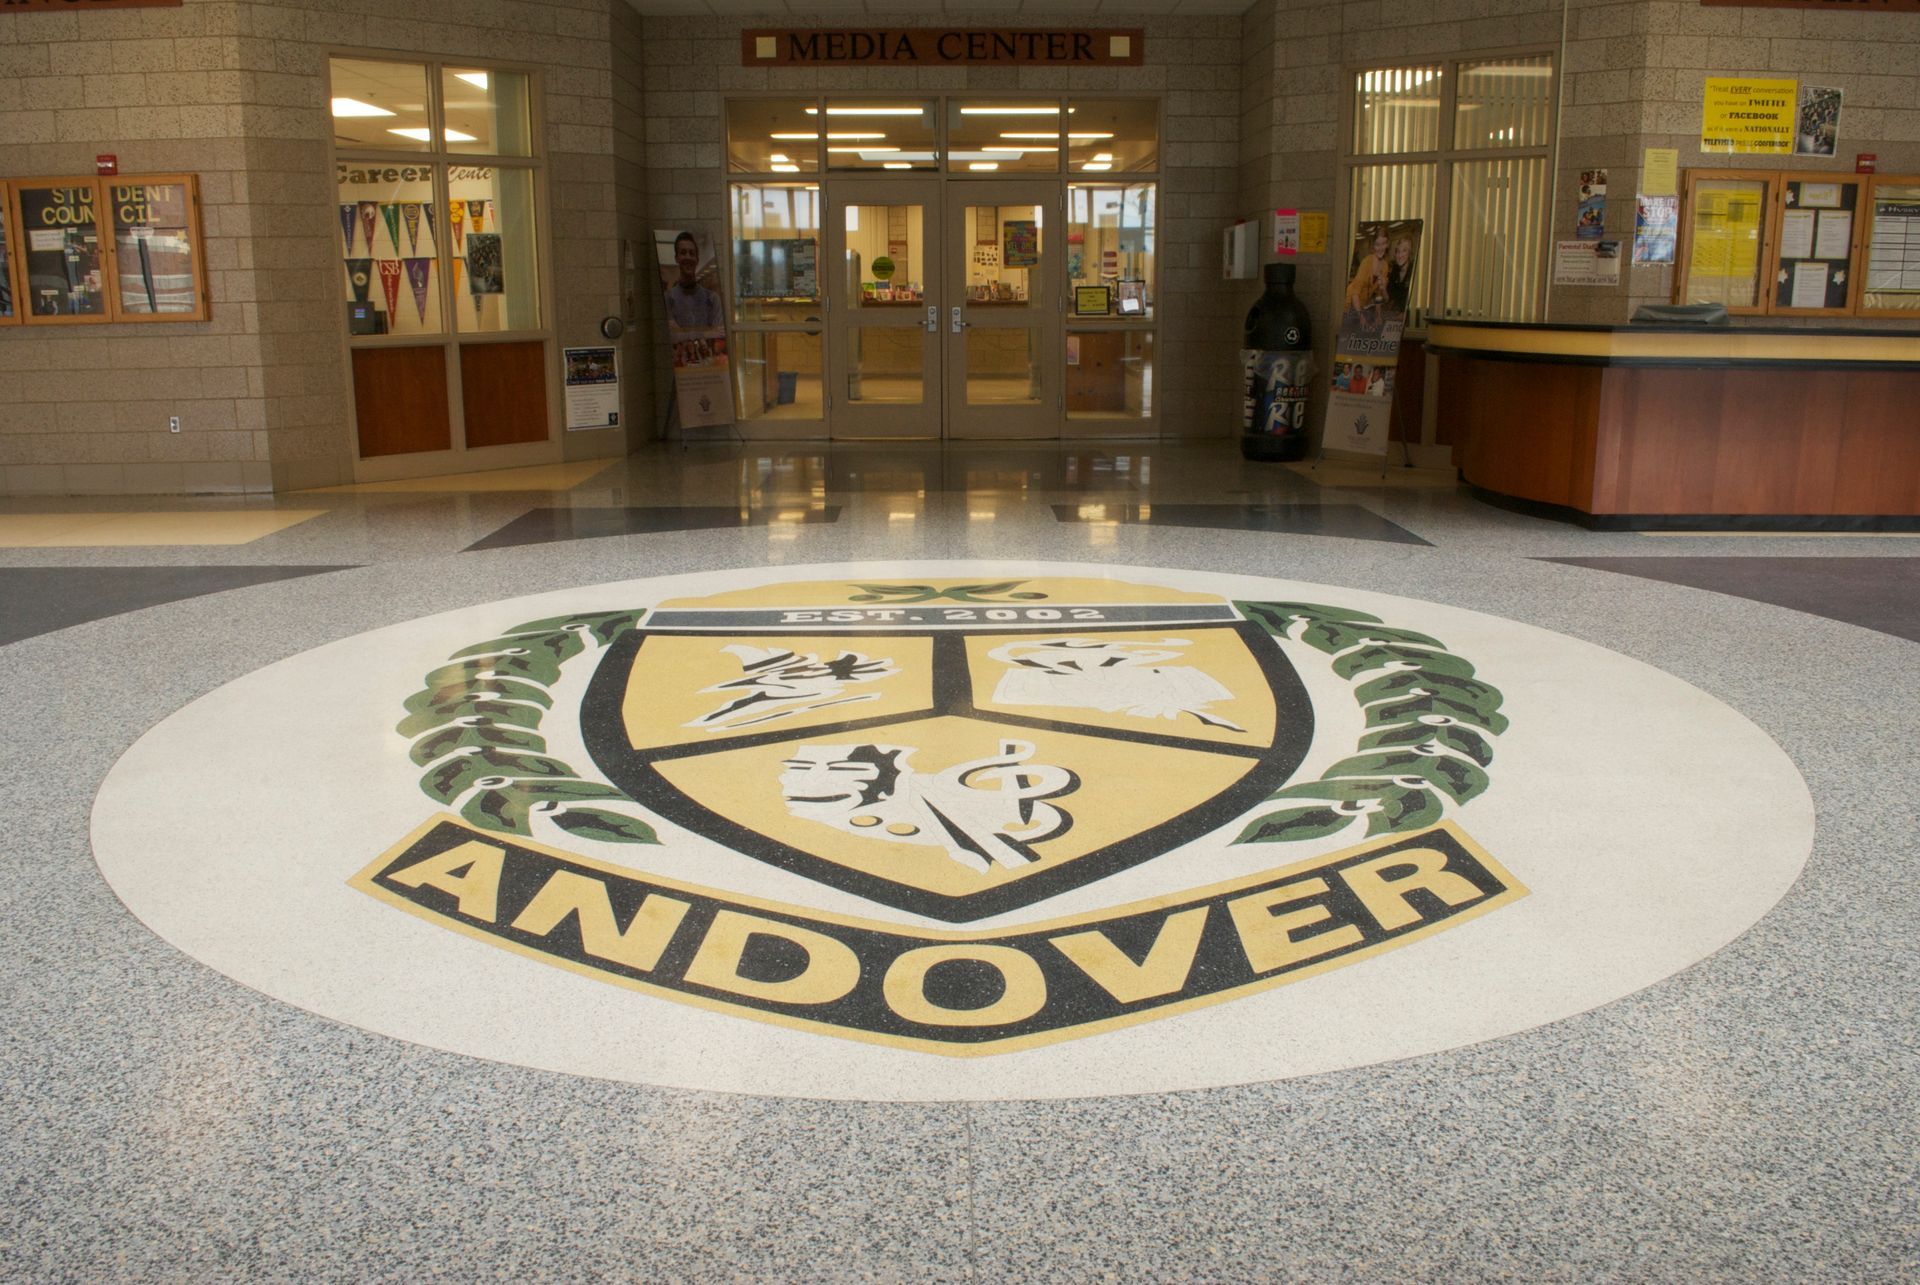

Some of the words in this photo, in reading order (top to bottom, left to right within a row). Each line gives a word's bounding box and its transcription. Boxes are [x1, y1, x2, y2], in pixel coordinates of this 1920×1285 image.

[787, 32, 918, 60] MEDIA
[935, 31, 1096, 60] CENTER
[1730, 86, 1752, 94] EVERY
[1748, 99, 1787, 107] TWITTER
[1728, 112, 1779, 120] FACEBOOK
[337, 165, 430, 185] Career
[1640, 196, 1665, 207] MAKE
[1643, 206, 1673, 218] STOP
[1346, 334, 1398, 355] inspire
[780, 609, 924, 623] EST.
[943, 608, 1105, 621] 2002
[386, 844, 1482, 1026] ANDOVER
